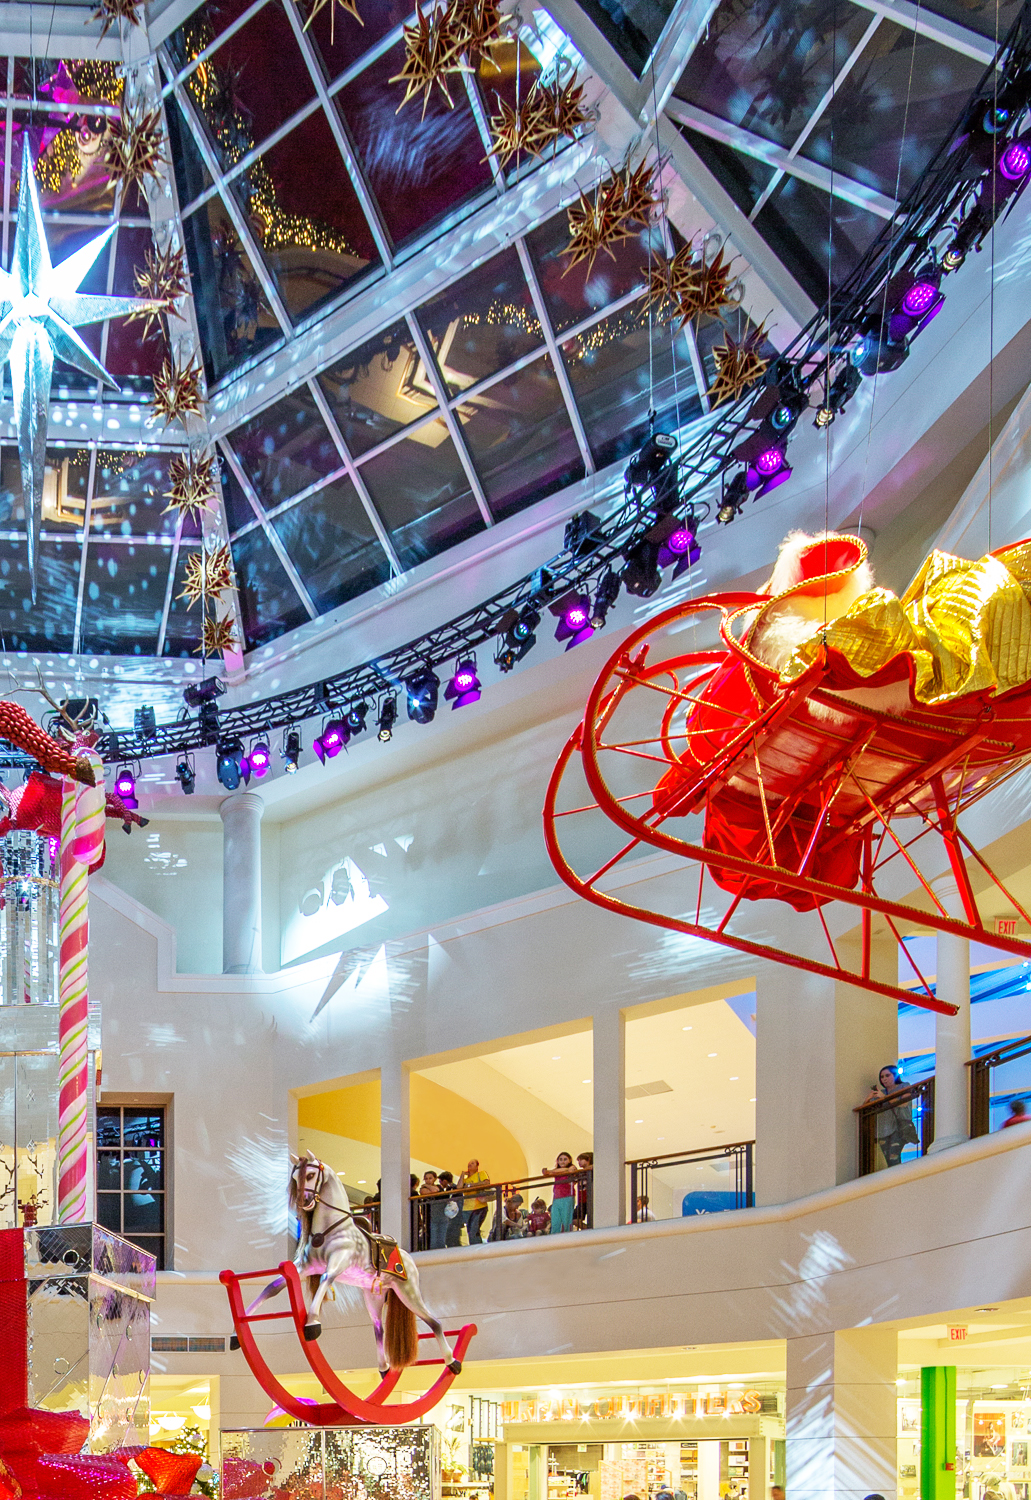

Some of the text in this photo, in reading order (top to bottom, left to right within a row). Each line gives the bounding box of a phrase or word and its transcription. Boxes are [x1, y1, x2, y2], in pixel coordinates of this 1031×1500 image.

[999, 921, 1016, 934] EXIT
[951, 1329, 966, 1340] EXIT
[501, 1389, 762, 1421] URBAN OUTFITTERS
